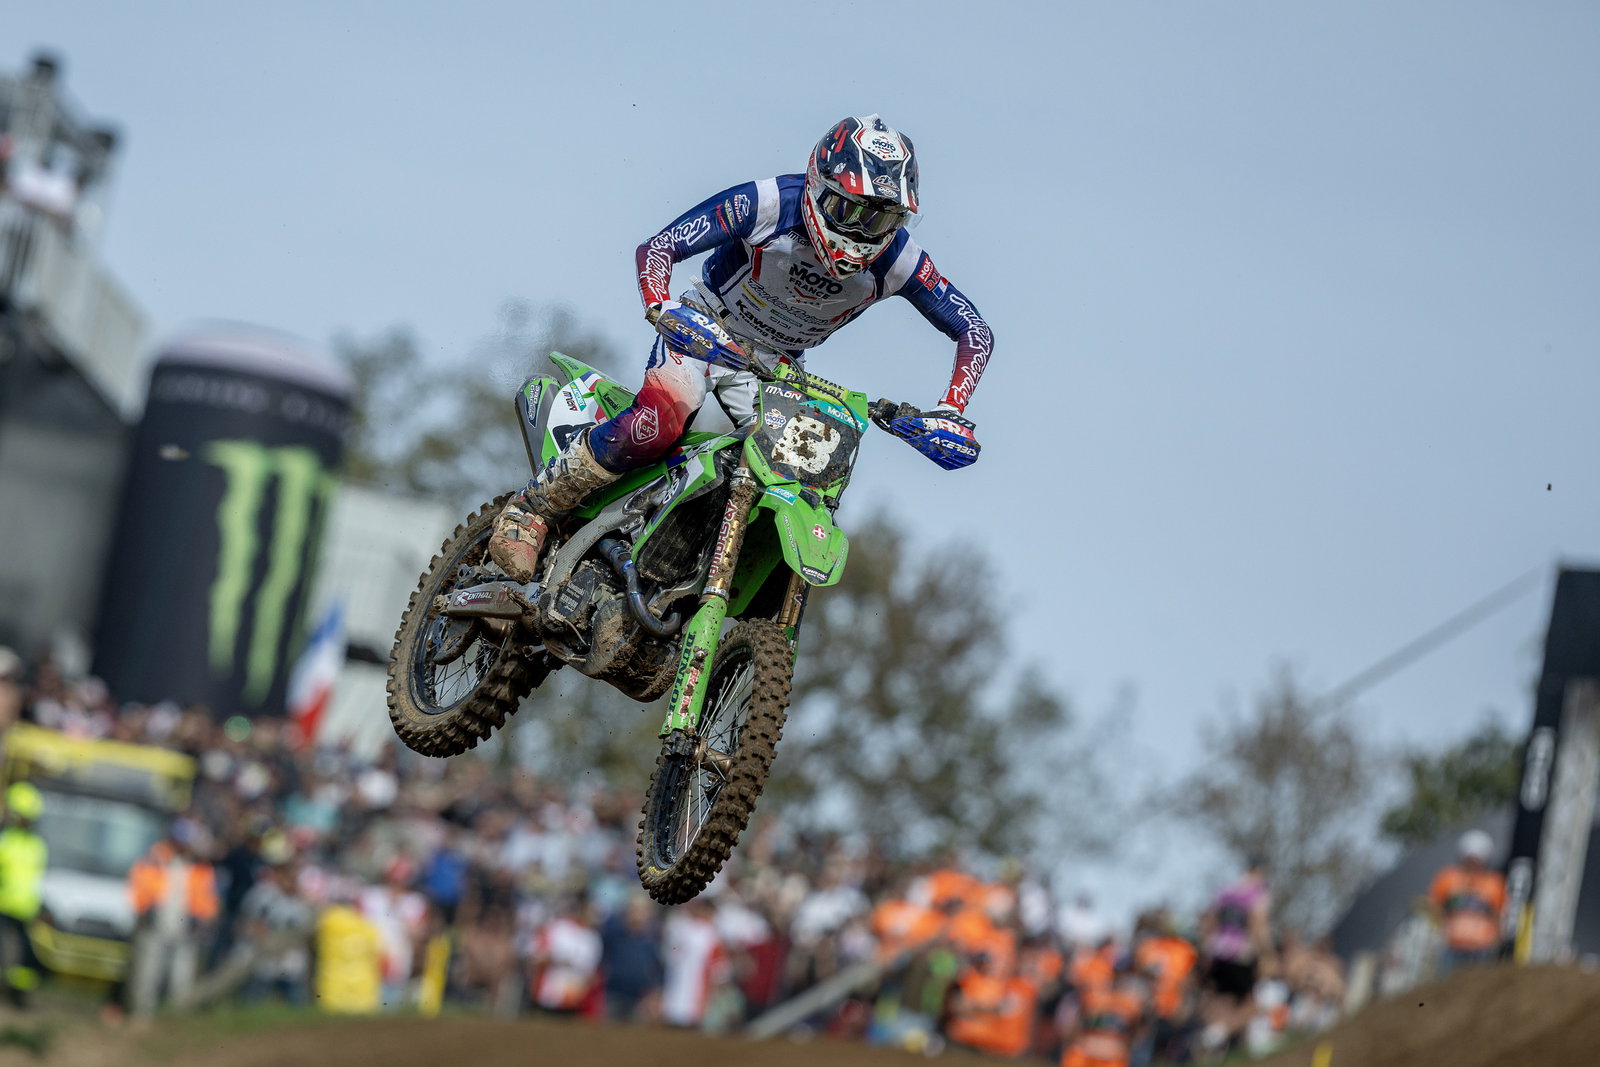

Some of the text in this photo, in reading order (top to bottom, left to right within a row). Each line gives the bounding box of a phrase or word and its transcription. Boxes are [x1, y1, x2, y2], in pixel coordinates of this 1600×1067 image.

[789, 264, 843, 295] MOTO
[918, 258, 932, 279] NGK
[789, 277, 831, 300] FRANCE
[736, 299, 811, 344] Kawasaki
[453, 591, 492, 606] RENTHAL
